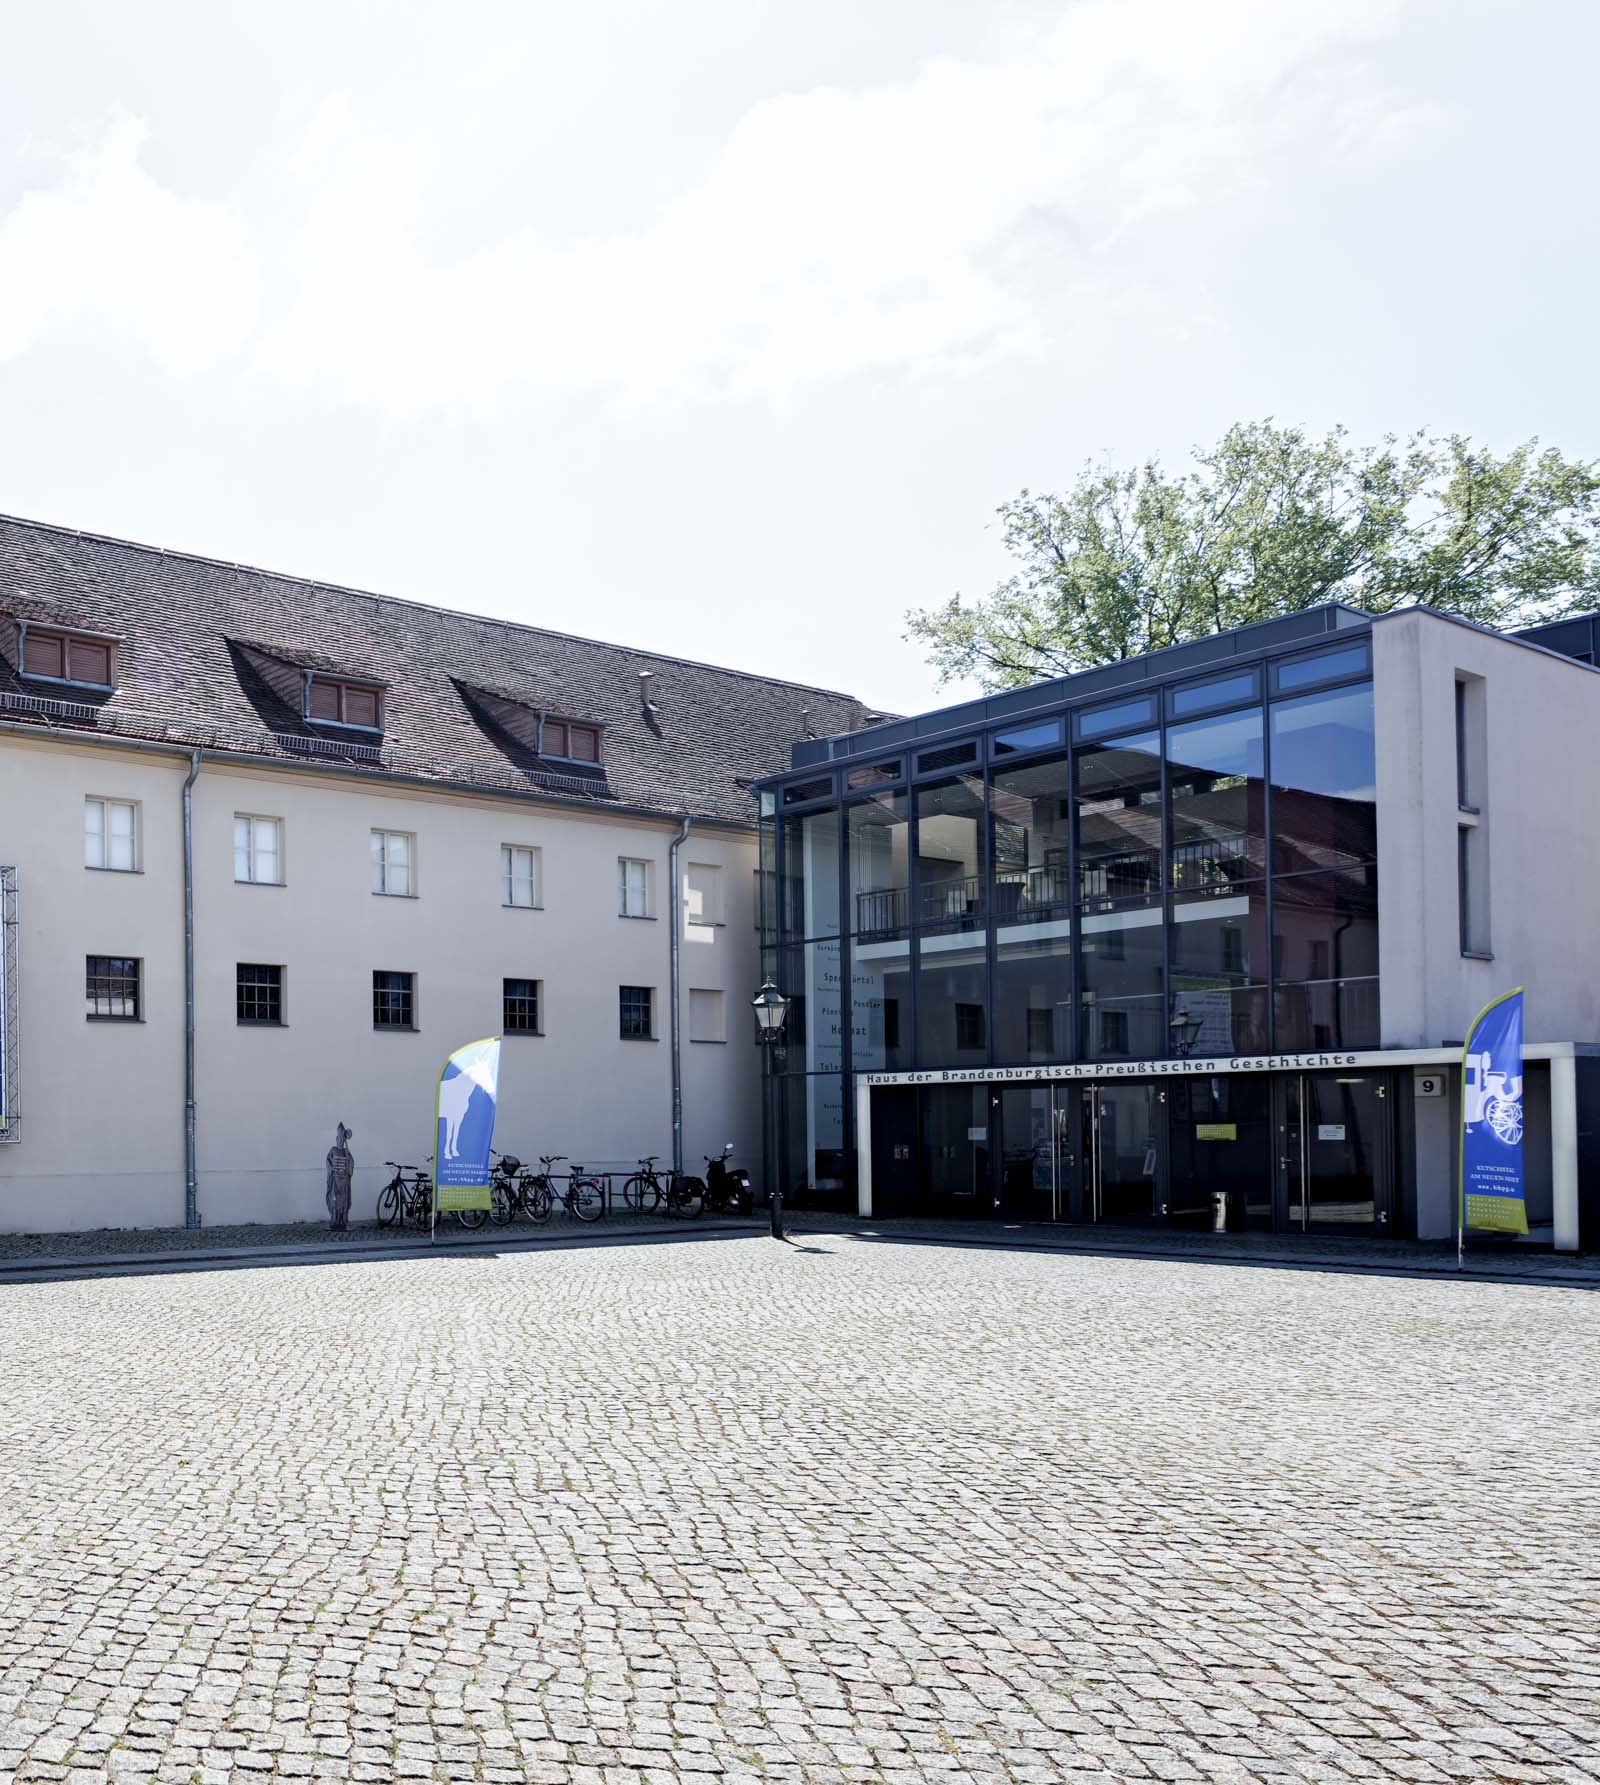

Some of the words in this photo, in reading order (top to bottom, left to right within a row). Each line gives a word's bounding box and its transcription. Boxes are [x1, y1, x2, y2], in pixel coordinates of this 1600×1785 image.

[867, 1074, 898, 1084] Haus
[908, 1072, 932, 1082] der
[942, 1060, 1215, 1081] Brandenburgisch-Preußischen
[1230, 1054, 1357, 1070] Geschichte
[1423, 1080, 1434, 1092] 9
